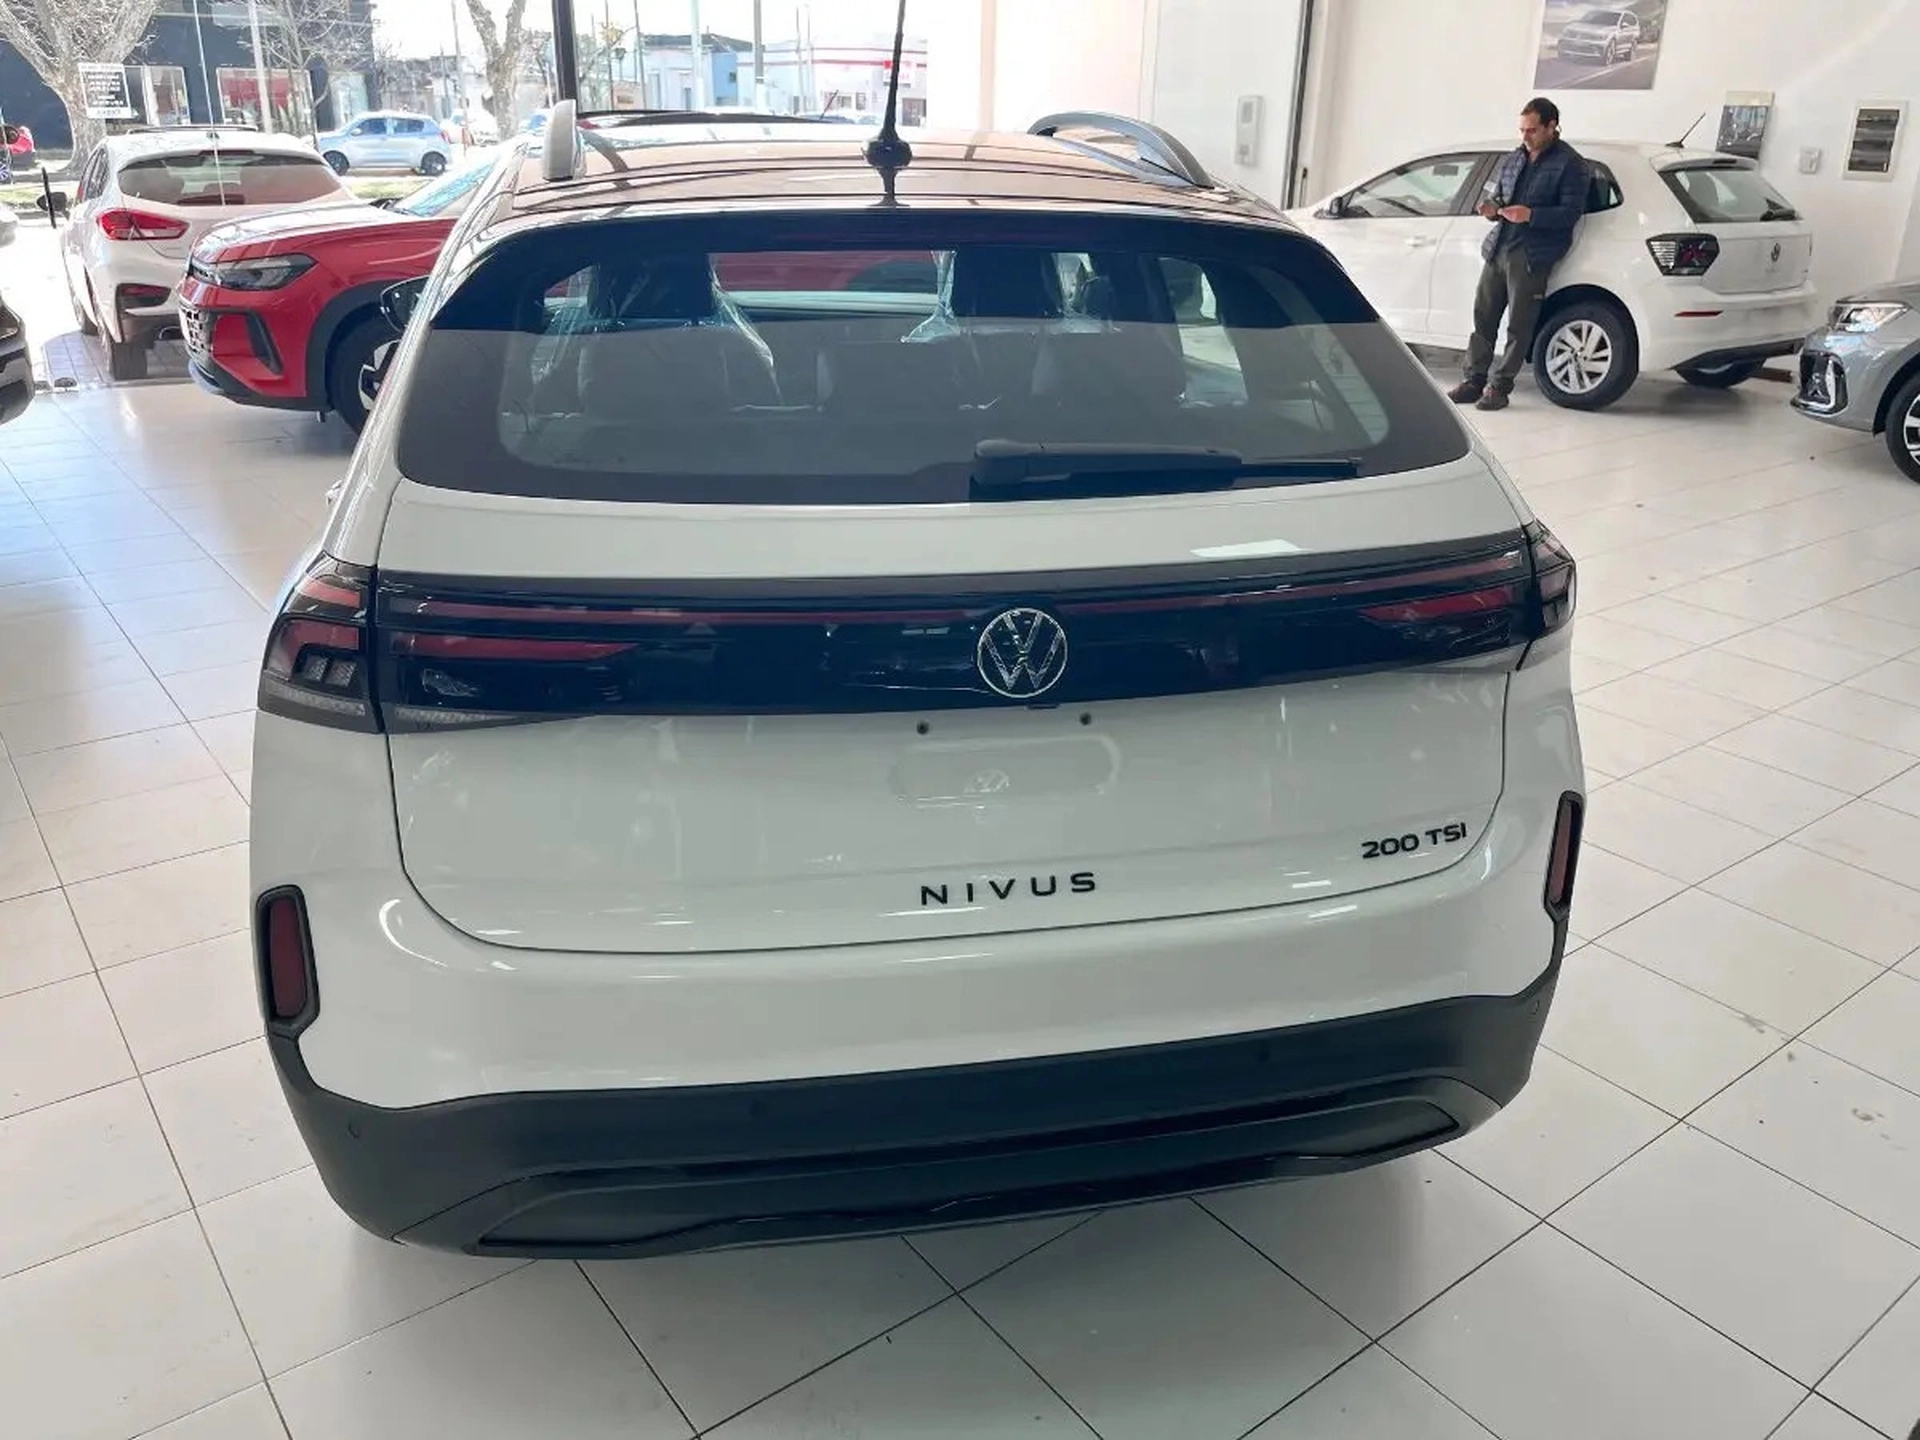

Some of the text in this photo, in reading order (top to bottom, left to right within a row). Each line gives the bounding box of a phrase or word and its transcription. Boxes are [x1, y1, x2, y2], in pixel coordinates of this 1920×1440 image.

[1362, 822, 1467, 860] 200 TSI
[920, 872, 1097, 906] NIVUS
